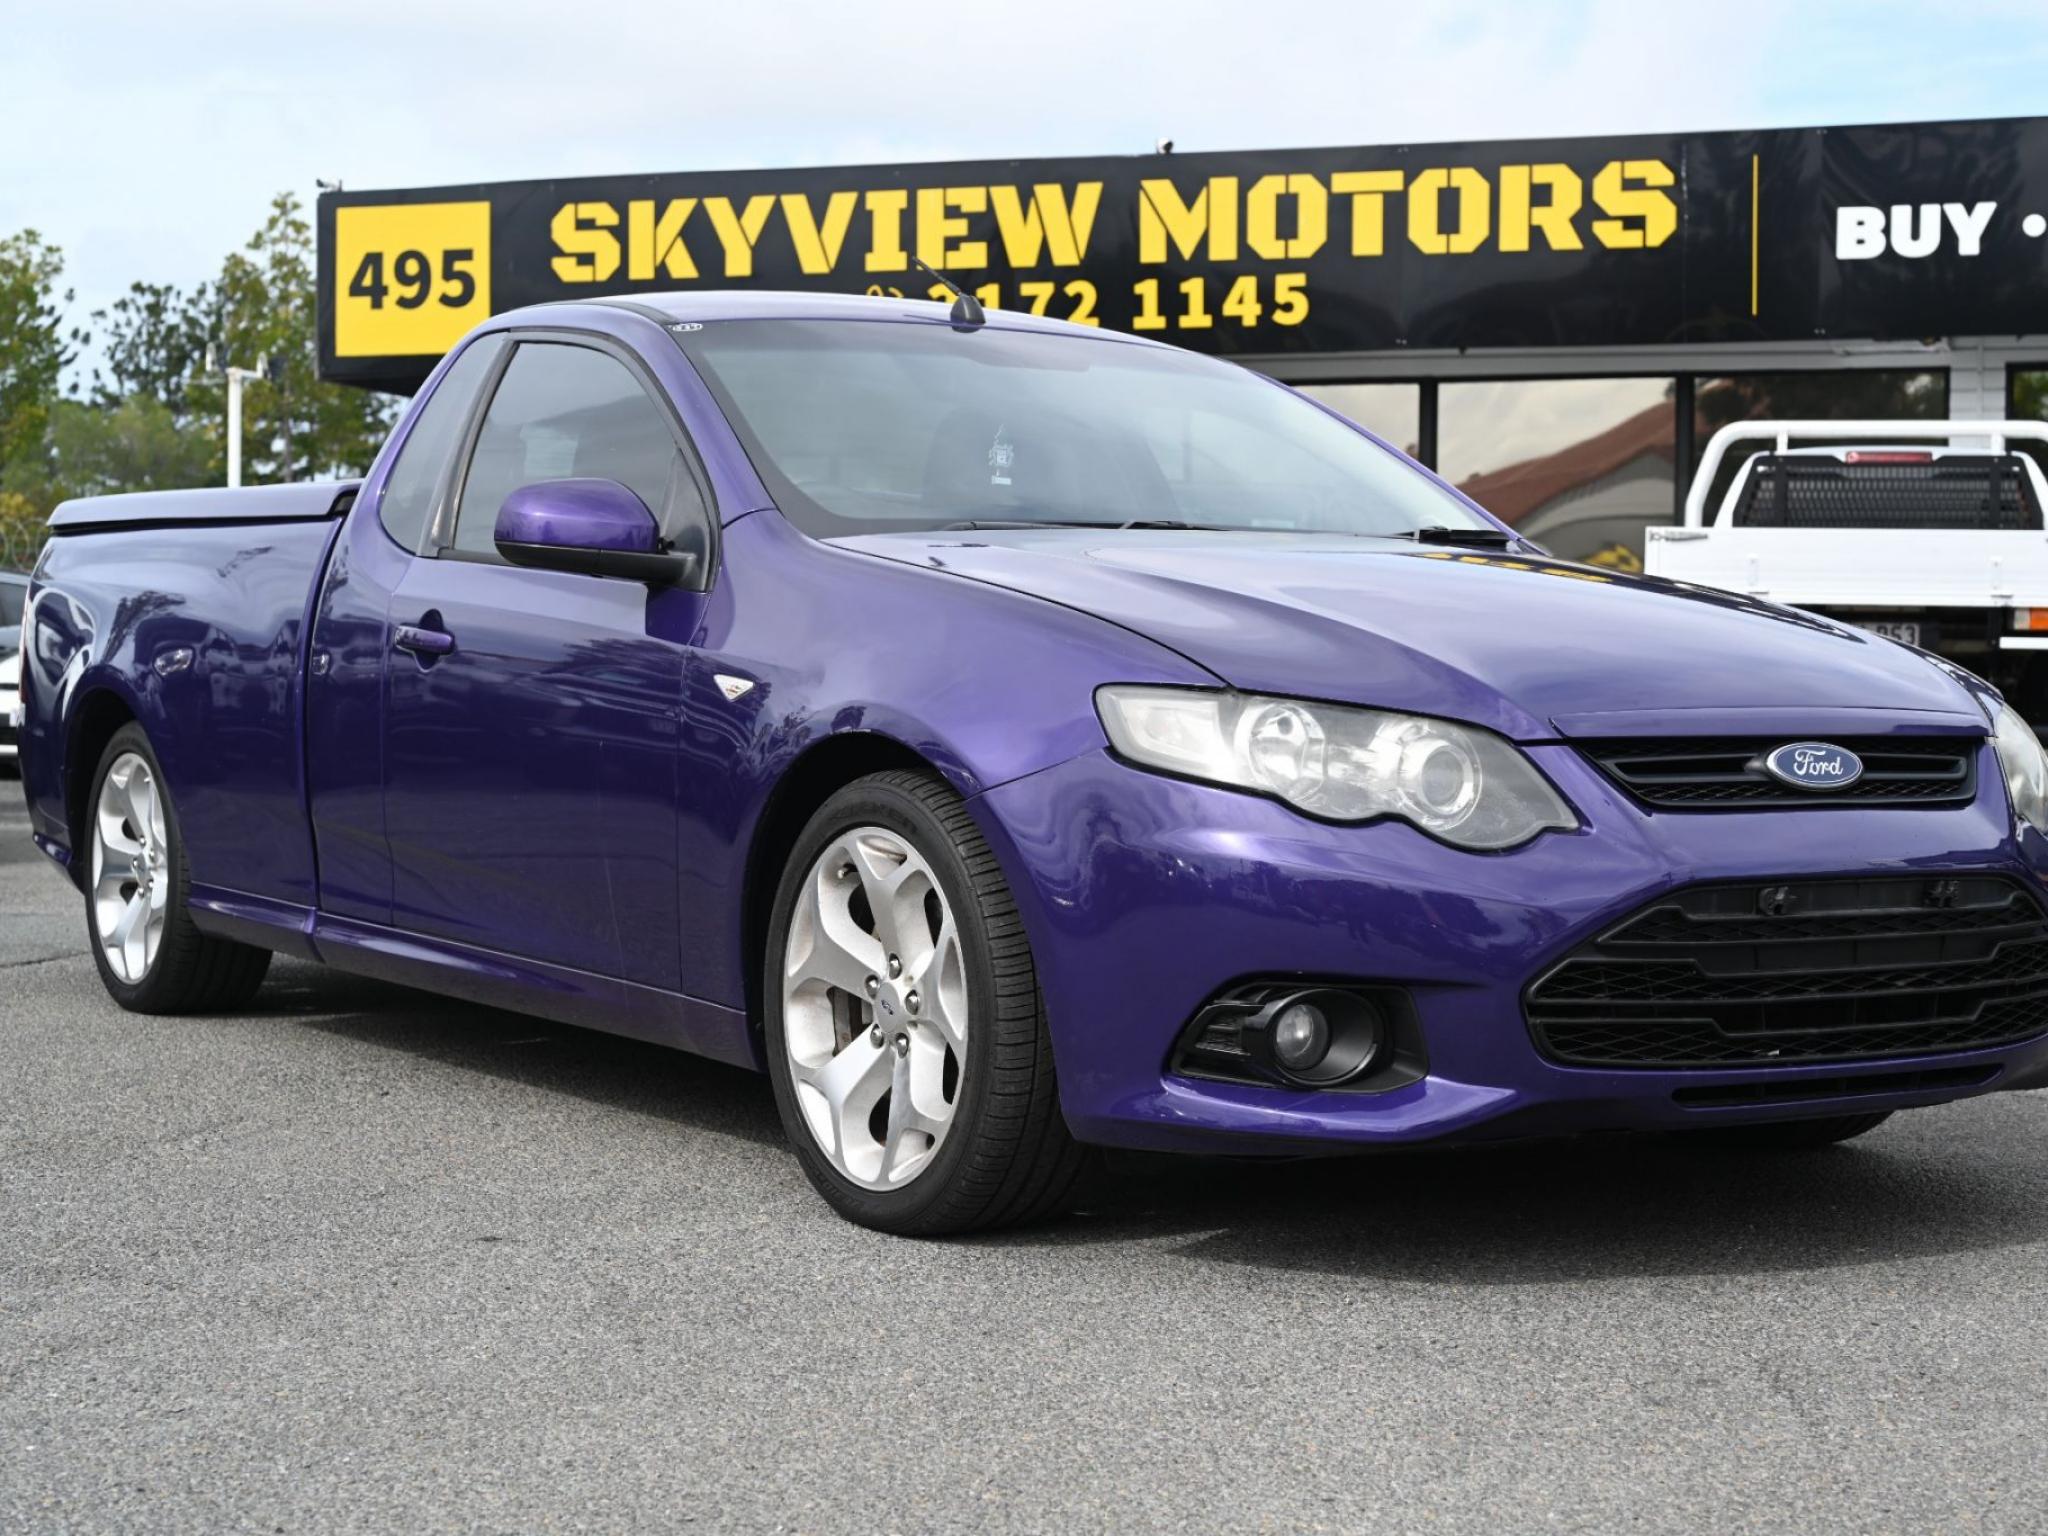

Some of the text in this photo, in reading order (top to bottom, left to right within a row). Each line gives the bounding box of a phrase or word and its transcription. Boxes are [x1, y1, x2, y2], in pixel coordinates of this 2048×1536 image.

[550, 159, 1677, 283] SKYVIEW MOTORS
[1835, 201, 1998, 260] BUY
[349, 249, 475, 309] 495
[1133, 272, 1309, 330] 1145
[1793, 748, 1843, 775] Ford
